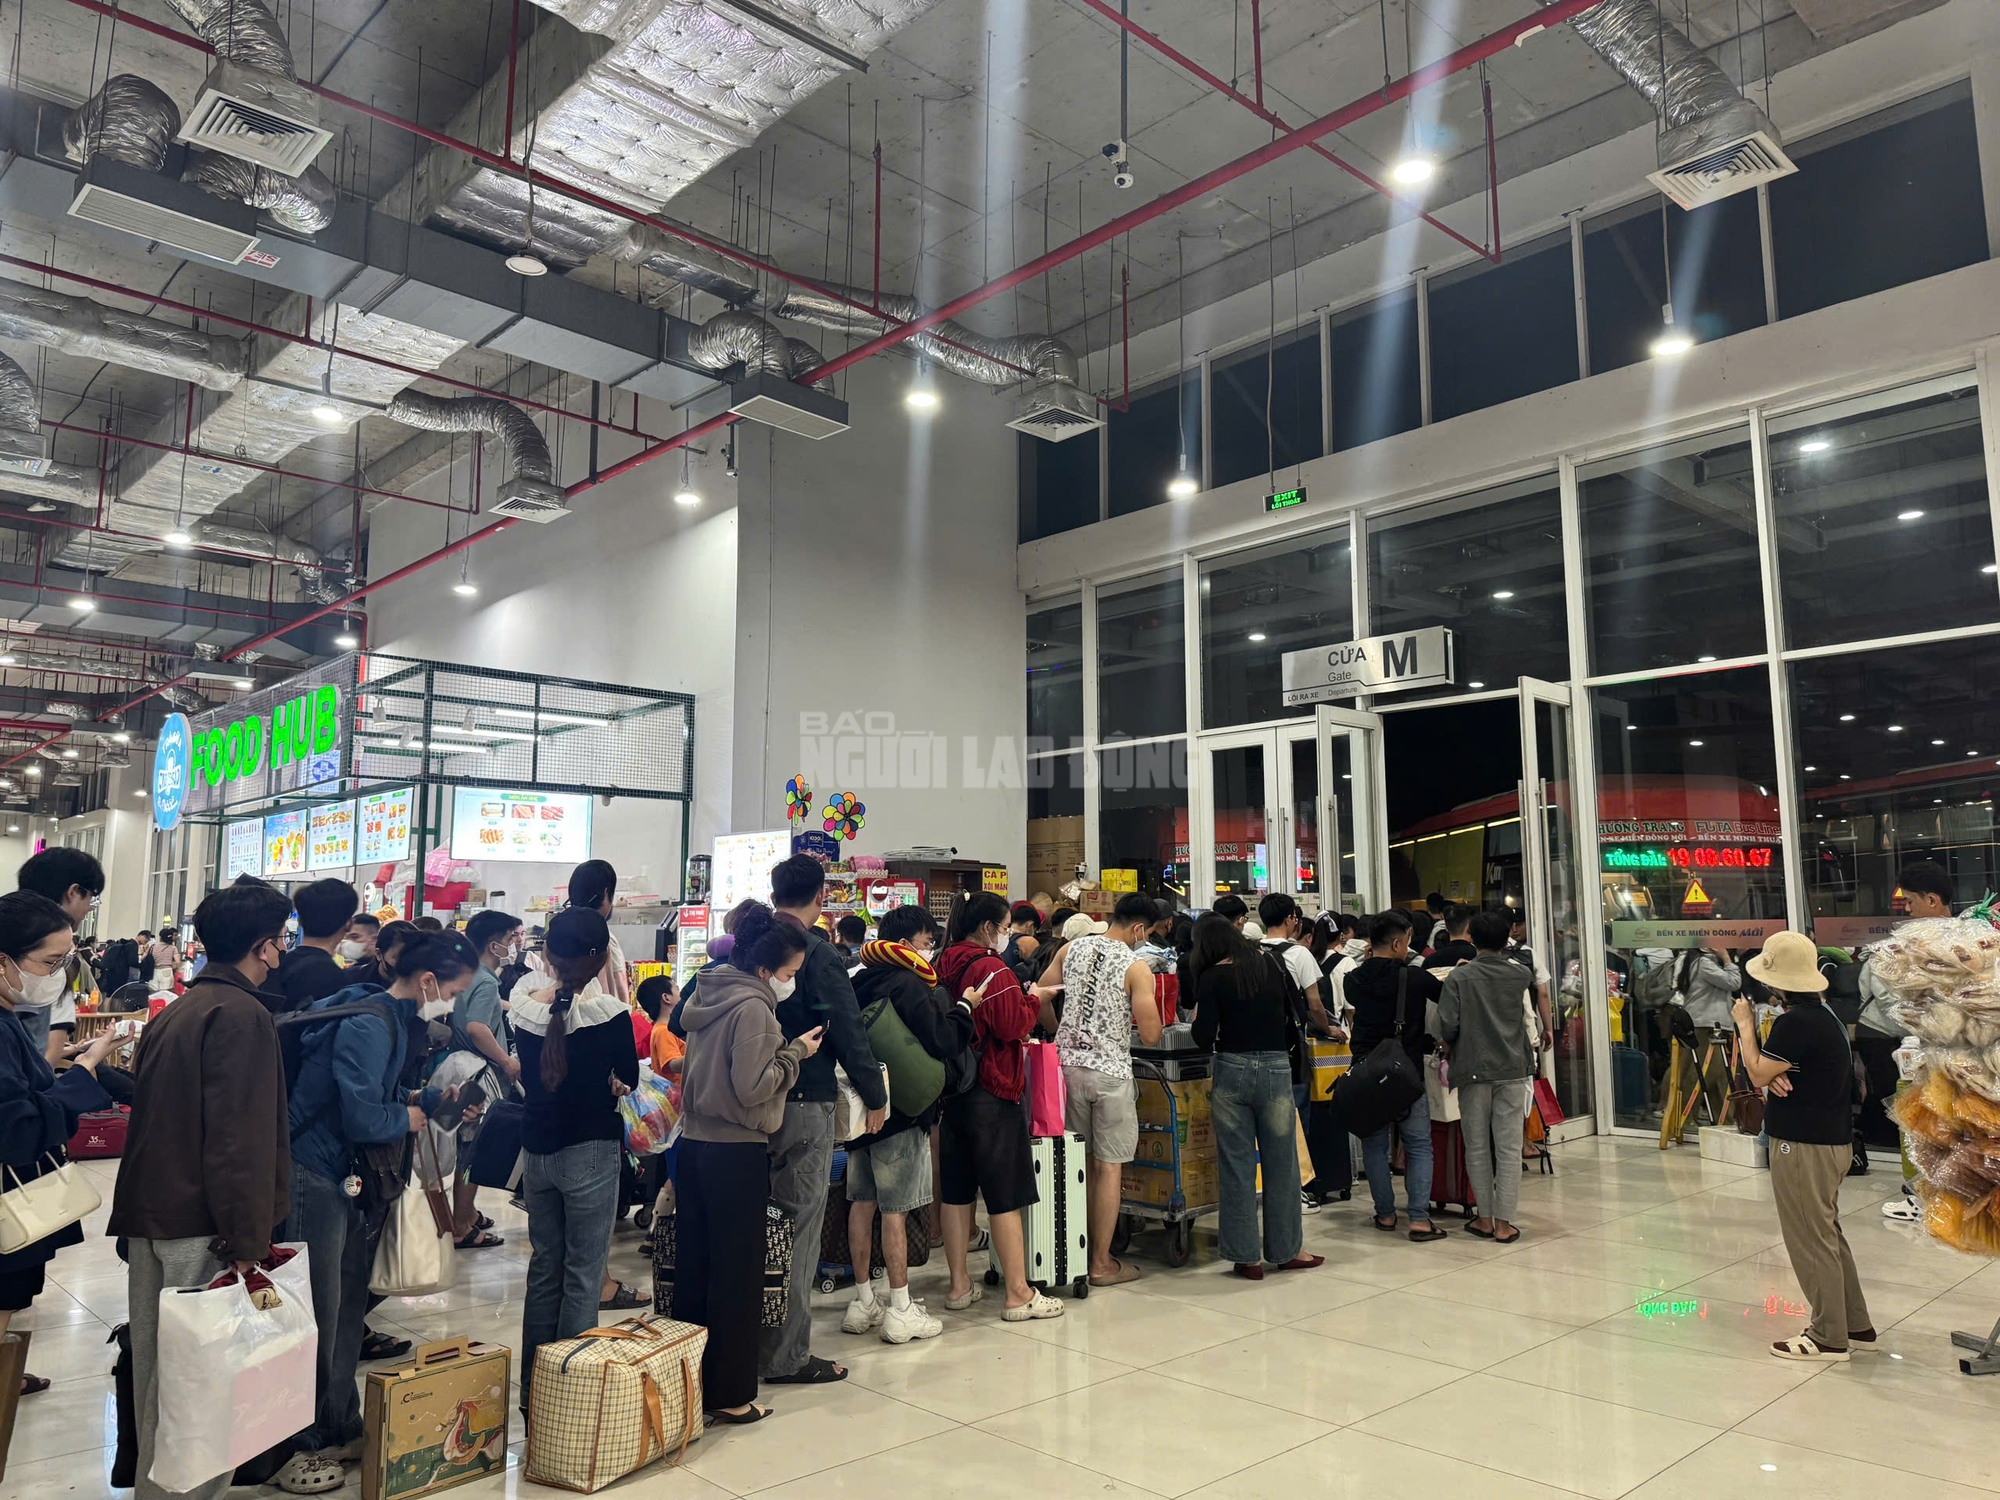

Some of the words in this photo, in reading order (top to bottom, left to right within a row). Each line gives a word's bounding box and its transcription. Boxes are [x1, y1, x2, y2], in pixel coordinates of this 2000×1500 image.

[1274, 490, 1298, 502] EXIT
[1328, 645, 1367, 667] CỬA
[1382, 636, 1418, 678] M
[1328, 671, 1352, 683] Gate
[1328, 687, 1357, 697] Departure
[190, 715, 263, 791] FOOD
[271, 685, 338, 770] HUB
[1597, 821, 1639, 834] HƯƠNG
[1643, 821, 1685, 832] TRANG
[1695, 821, 1733, 833] FUTA
[1733, 821, 1756, 834] Bus
[1214, 844, 1238, 854] RANG
[1605, 848, 1640, 866] TỔNG
[1667, 848, 1691, 867] 19
[1694, 847, 1772, 867] 00.60.67
[1712, 928, 1737, 937] ĐÔNG
